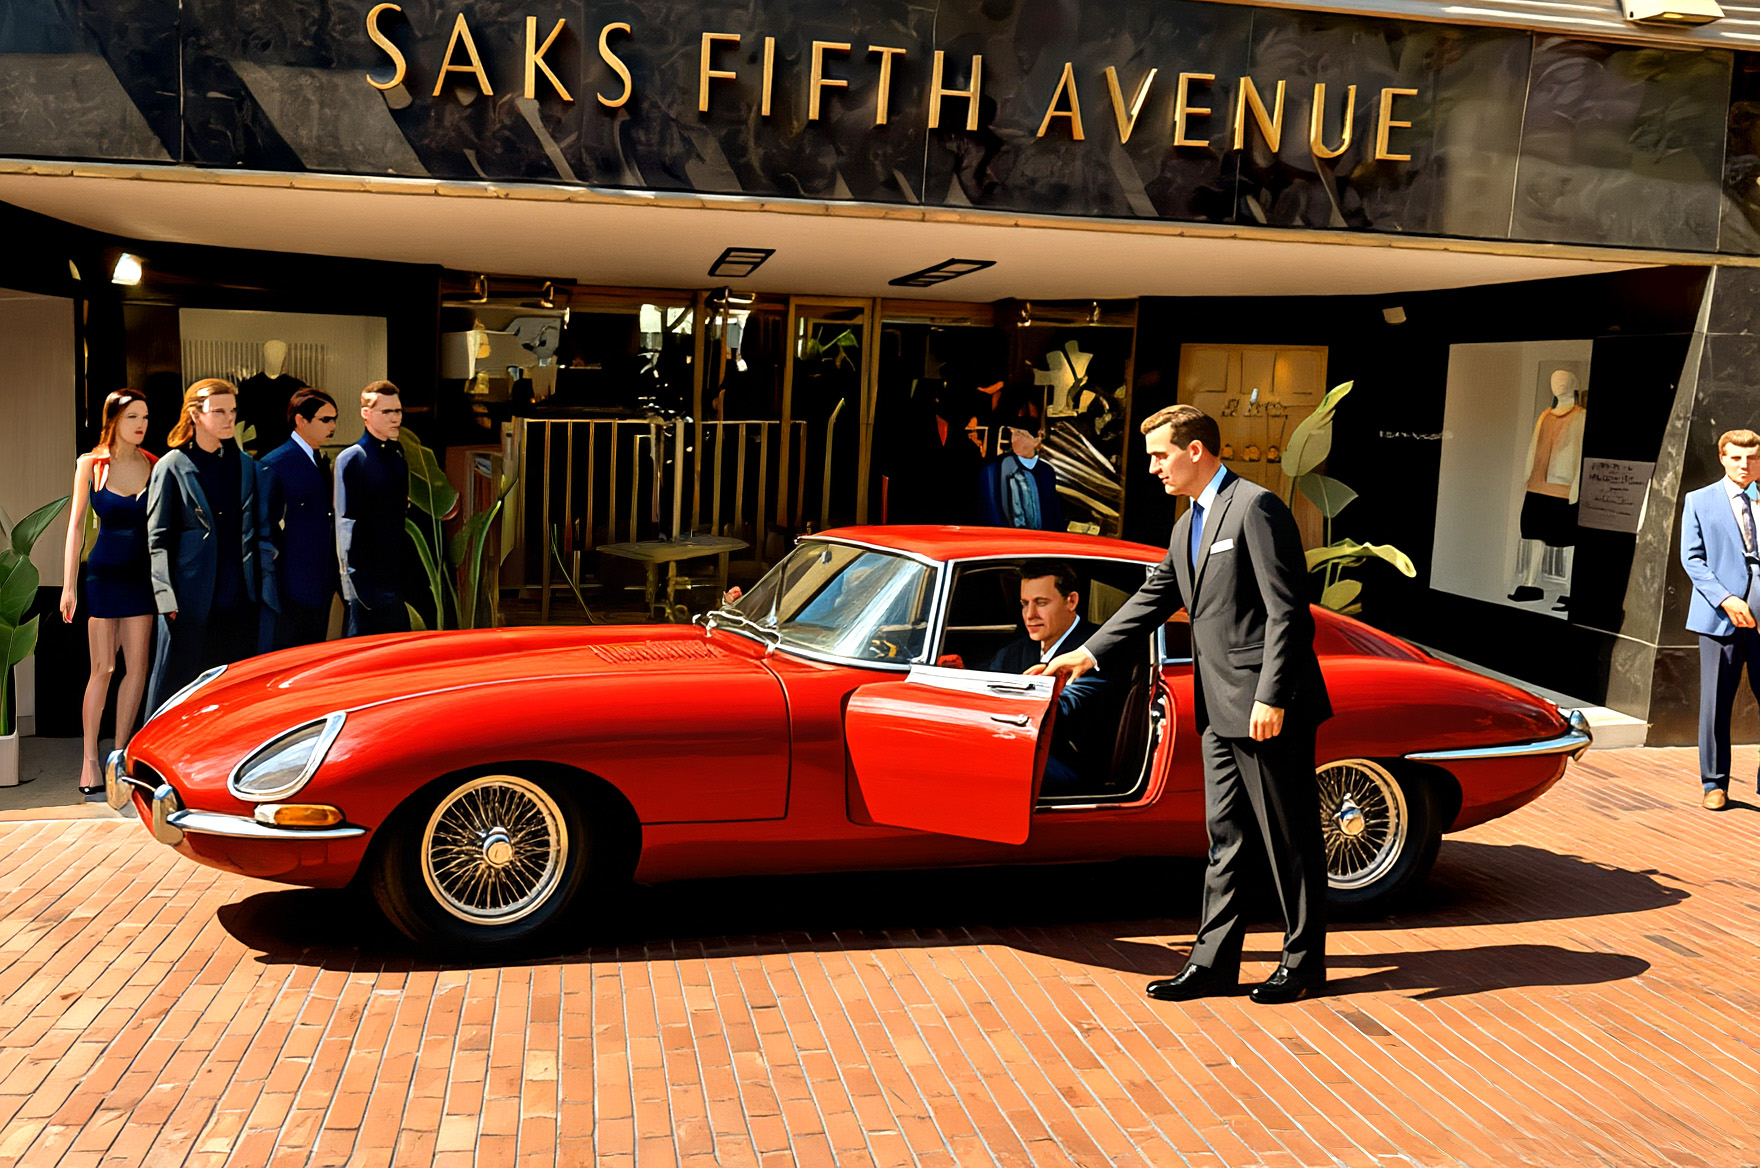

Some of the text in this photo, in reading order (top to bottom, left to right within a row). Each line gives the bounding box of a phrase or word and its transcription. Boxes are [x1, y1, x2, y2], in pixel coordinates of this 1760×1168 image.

[365, 2, 1420, 162] SAKS FIFTH AVENUE
